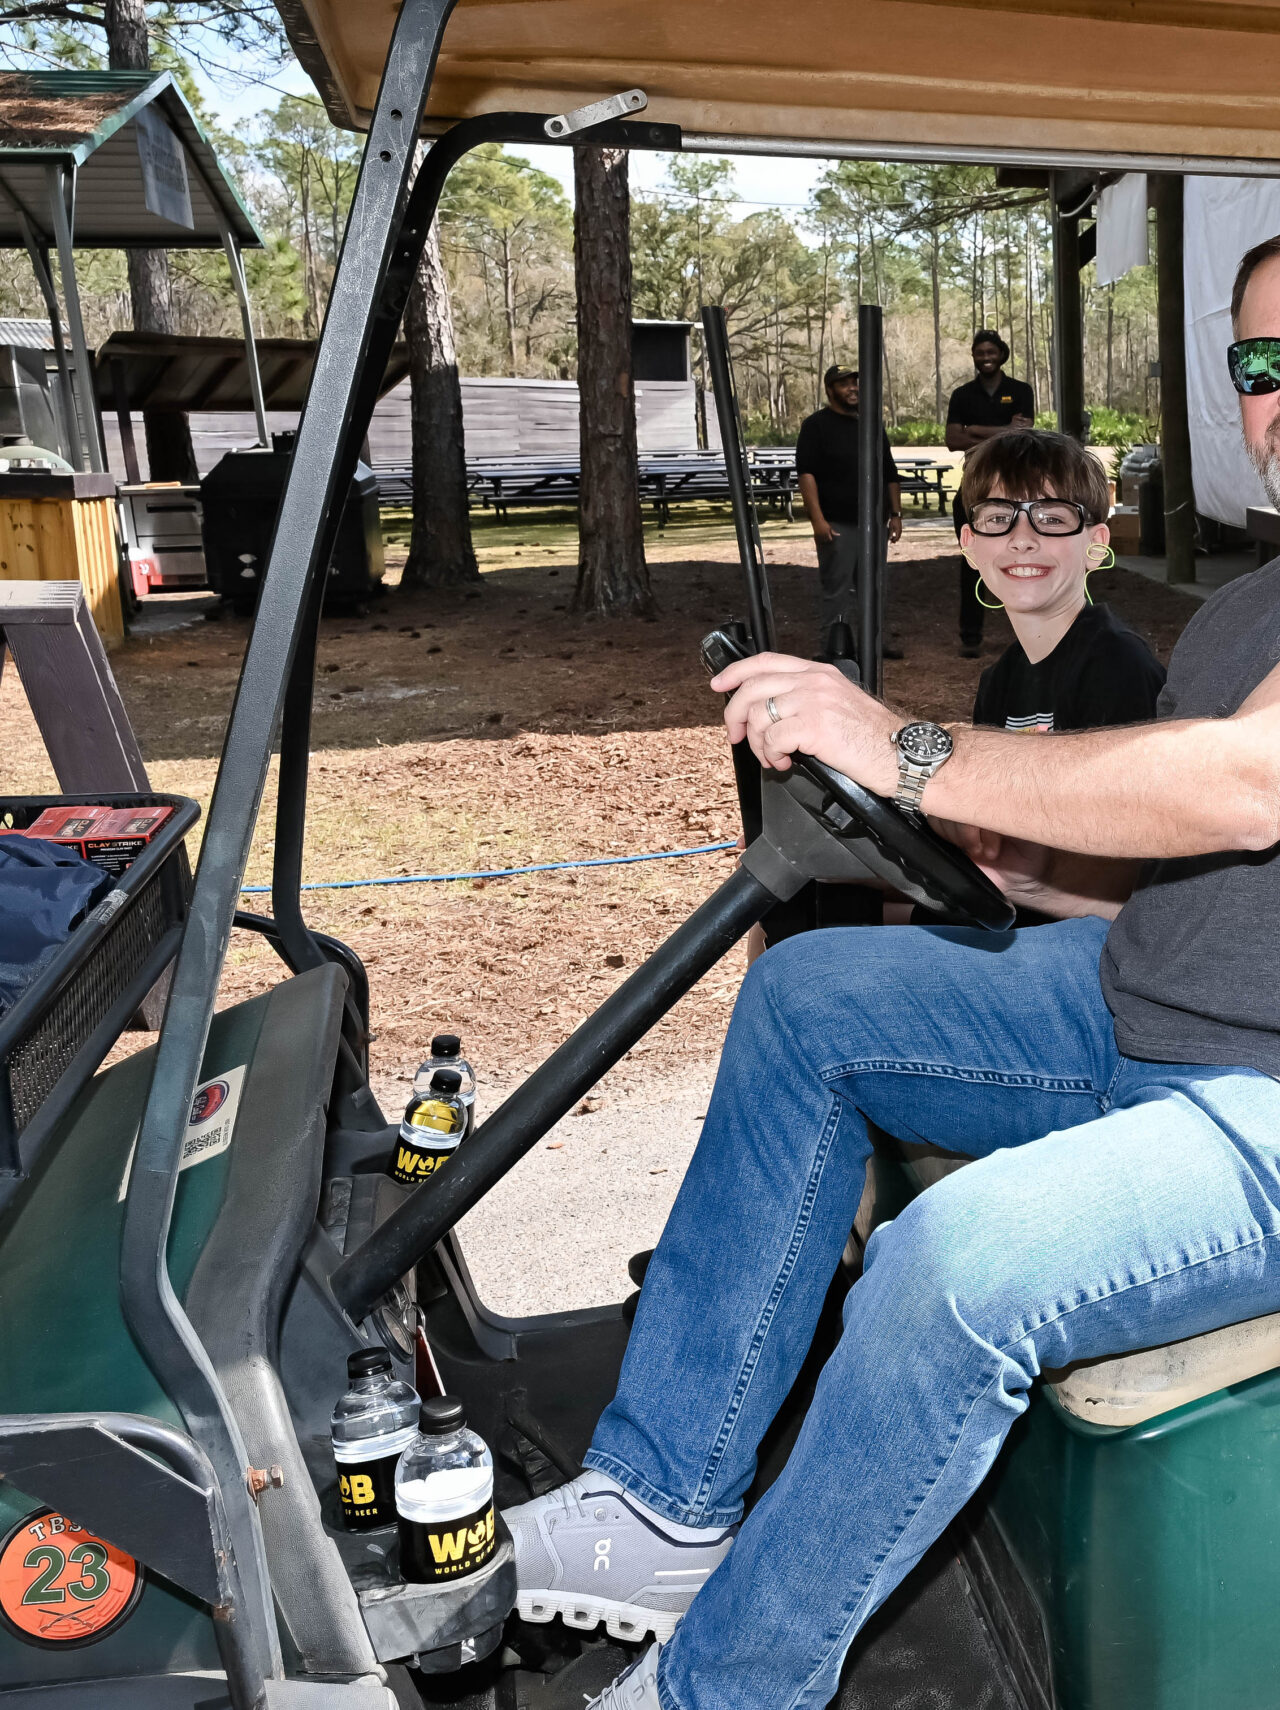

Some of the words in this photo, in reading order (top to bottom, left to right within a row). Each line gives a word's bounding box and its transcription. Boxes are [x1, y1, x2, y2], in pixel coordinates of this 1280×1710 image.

[355, 1508, 378, 1517] BEER
[29, 1515, 95, 1542] TBS
[21, 1541, 111, 1606] 23
[434, 1561, 471, 1575] WORLD
